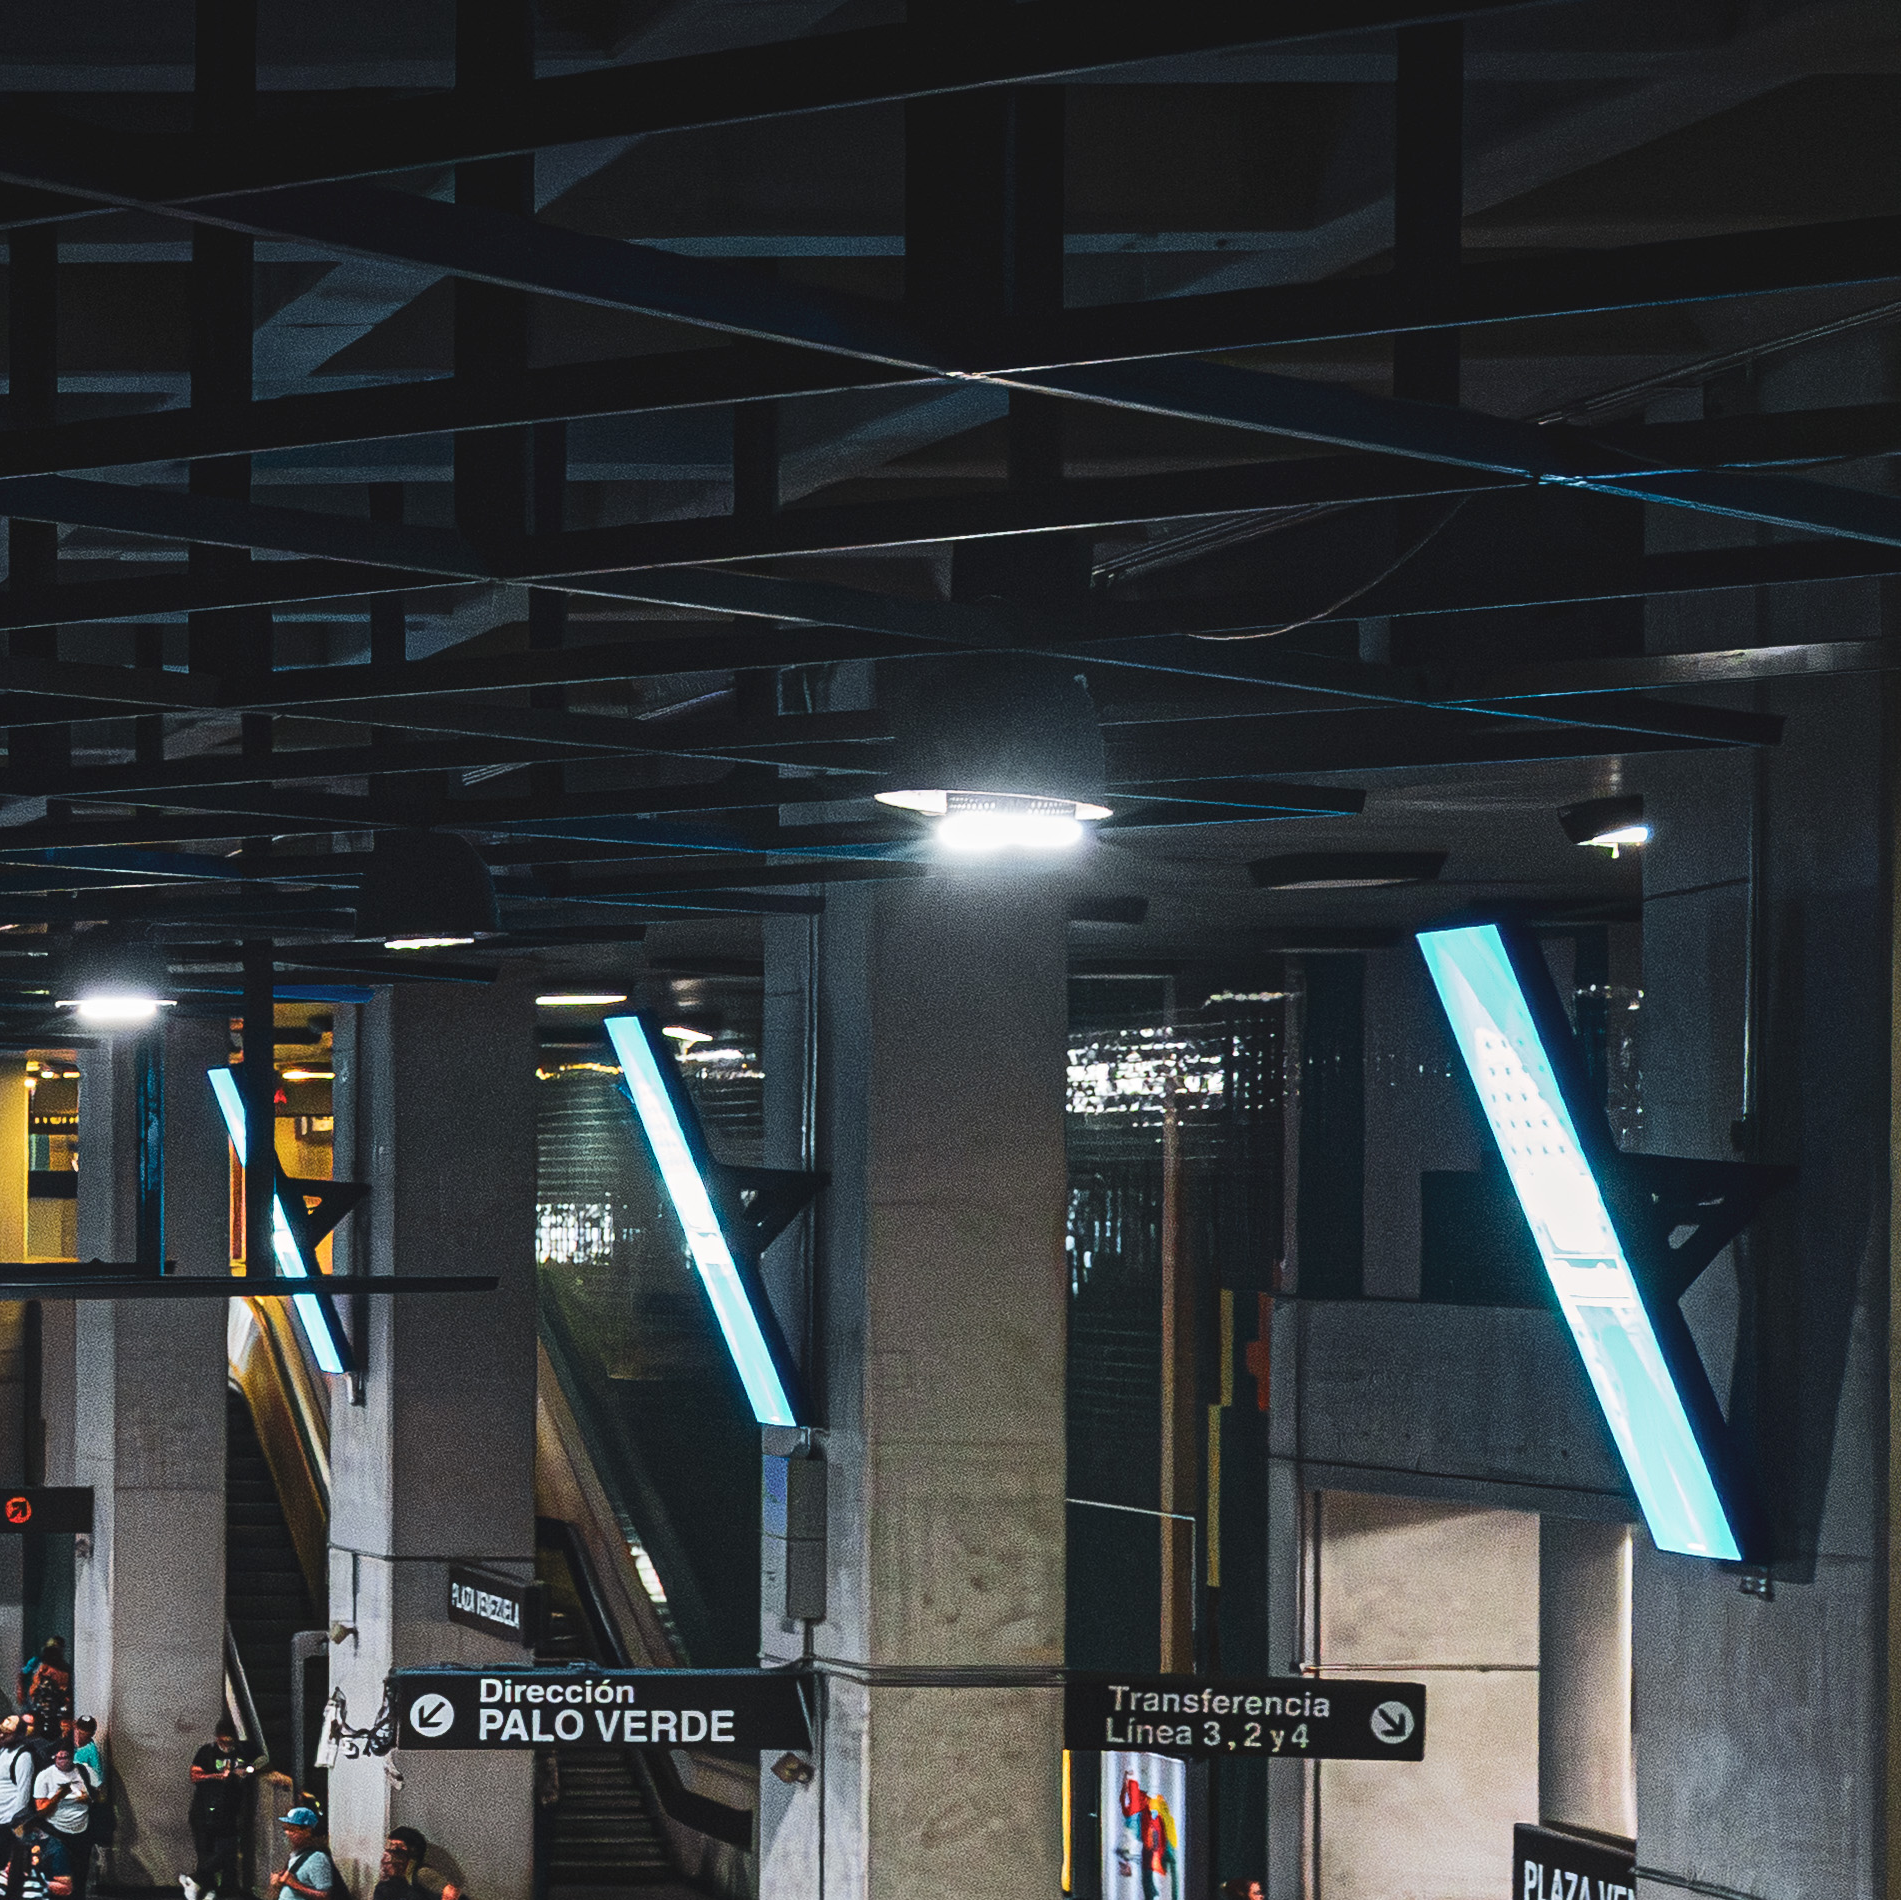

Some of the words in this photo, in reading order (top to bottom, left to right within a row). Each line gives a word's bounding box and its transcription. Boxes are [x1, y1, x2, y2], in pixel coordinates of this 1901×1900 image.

[479, 1678, 635, 1704] Dirección
[1108, 1684, 1330, 1718] Transferencia
[479, 1708, 585, 1742] PALO
[594, 1708, 736, 1743] VERDE
[1106, 1716, 1193, 1745] Línea
[1243, 1721, 1262, 1747] 2
[1269, 1729, 1285, 1752] y
[1291, 1722, 1310, 1749] 4
